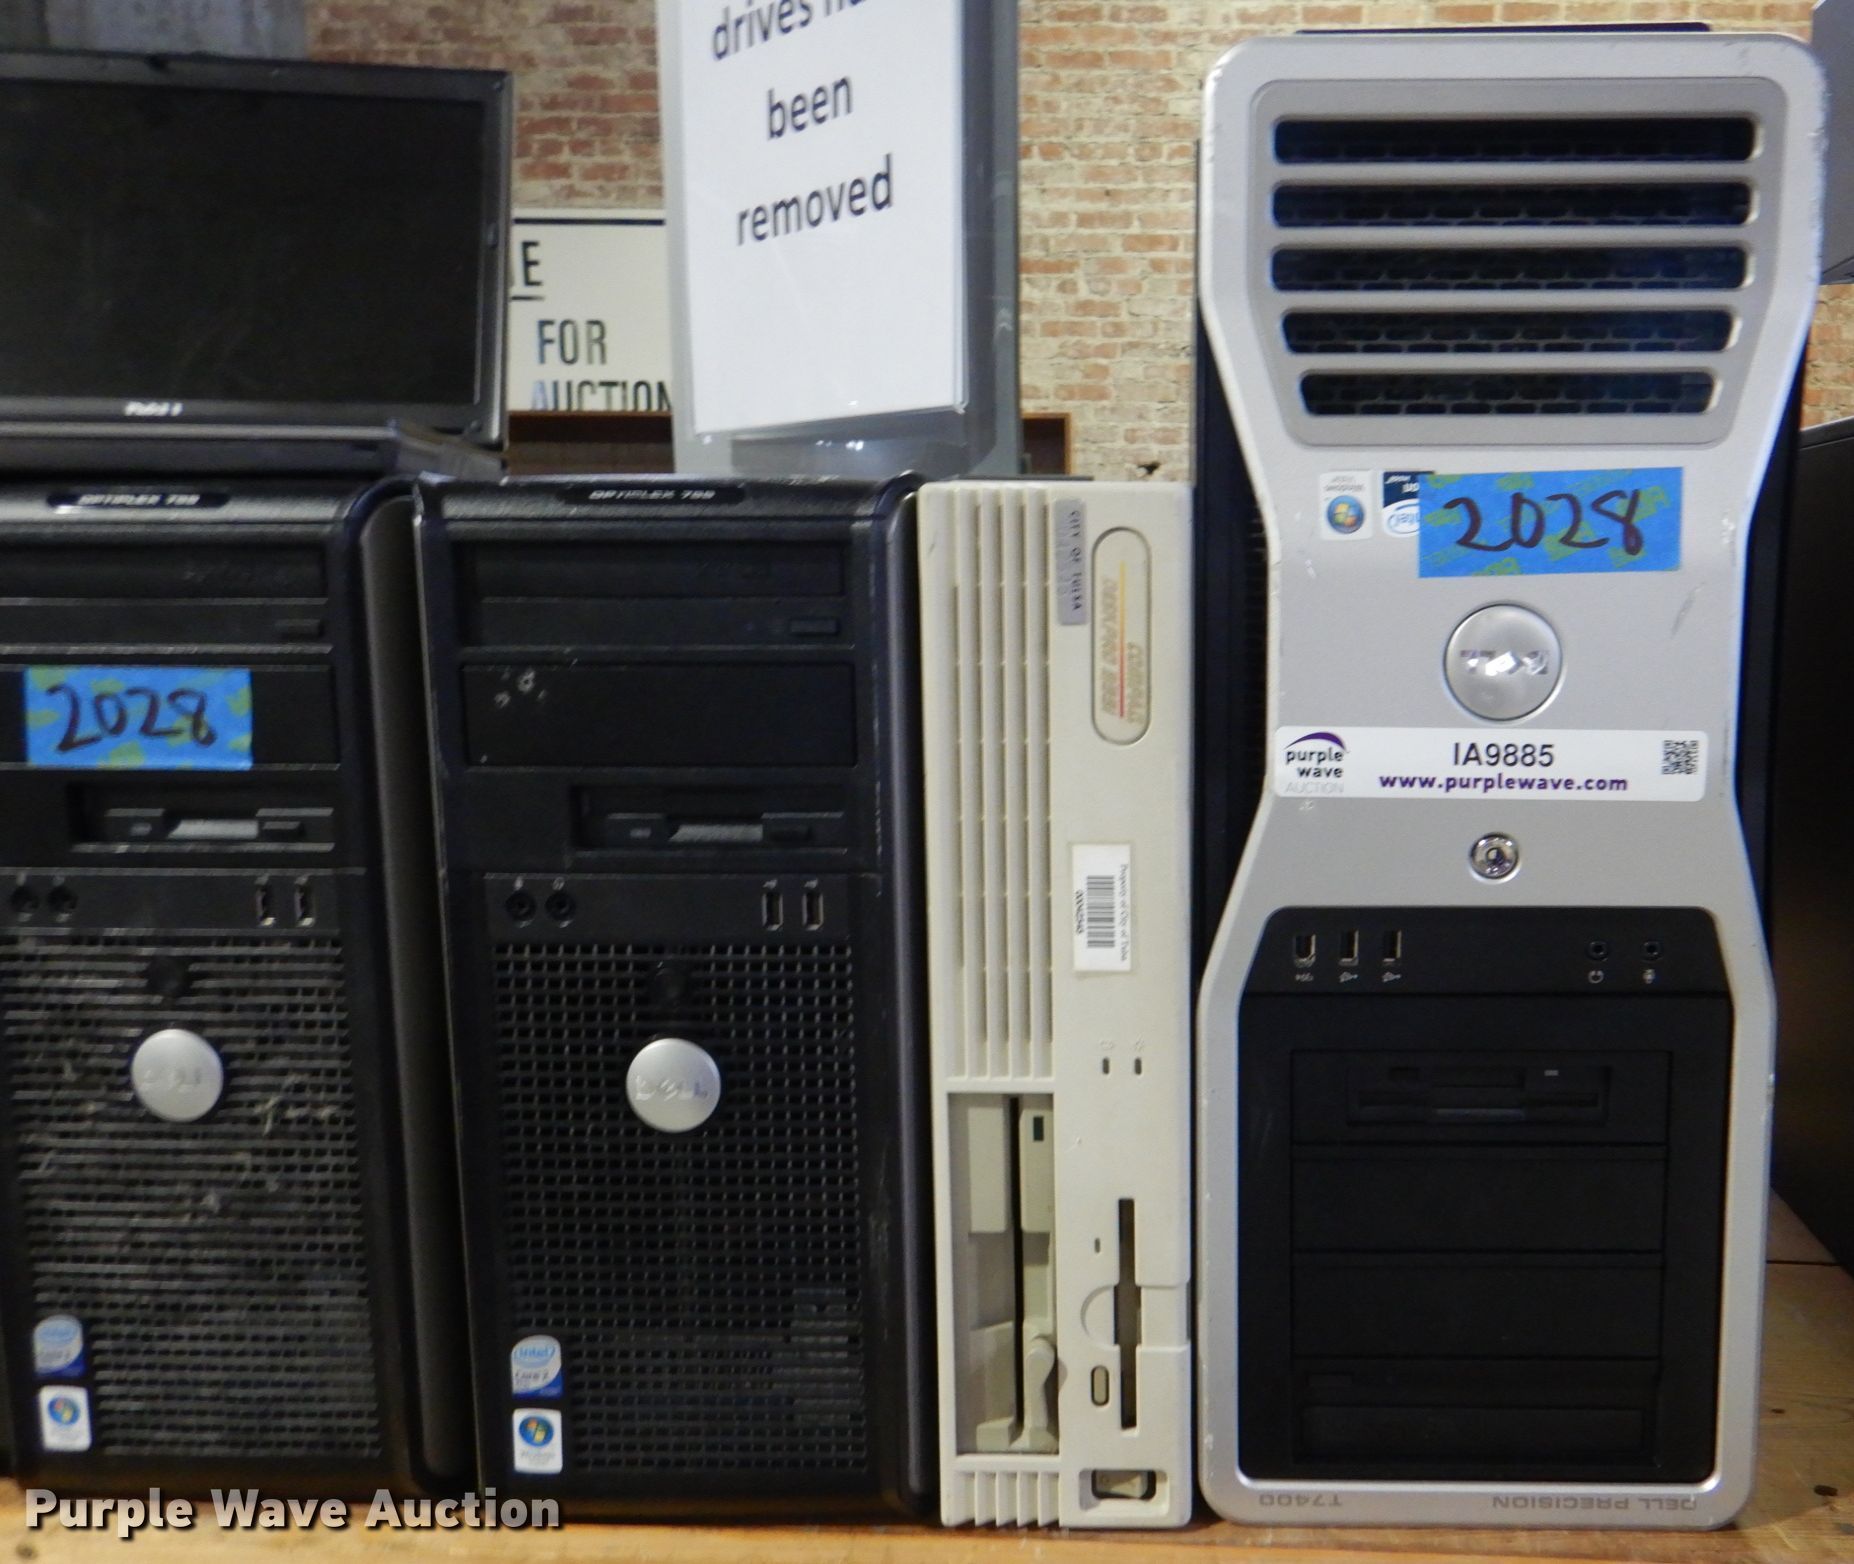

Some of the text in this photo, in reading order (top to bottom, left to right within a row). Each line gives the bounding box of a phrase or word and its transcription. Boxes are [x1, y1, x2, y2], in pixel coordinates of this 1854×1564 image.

[712, 0, 813, 62] drives
[767, 75, 854, 141] been
[736, 152, 893, 247] removed
[537, 319, 607, 366] FOR
[1442, 489, 1644, 557] 2028
[1070, 511, 1083, 612] CITY OF TULSA
[46, 682, 218, 755] 2028
[1285, 747, 1344, 765] purple
[1296, 767, 1344, 779] wave
[1452, 742, 1556, 768] IA9885
[1285, 781, 1344, 794] AUCTION
[1378, 772, 1629, 794] www.purplewave.com
[1258, 1494, 1343, 1507] T7400
[1491, 1496, 1697, 1511] DELL PRECISION
